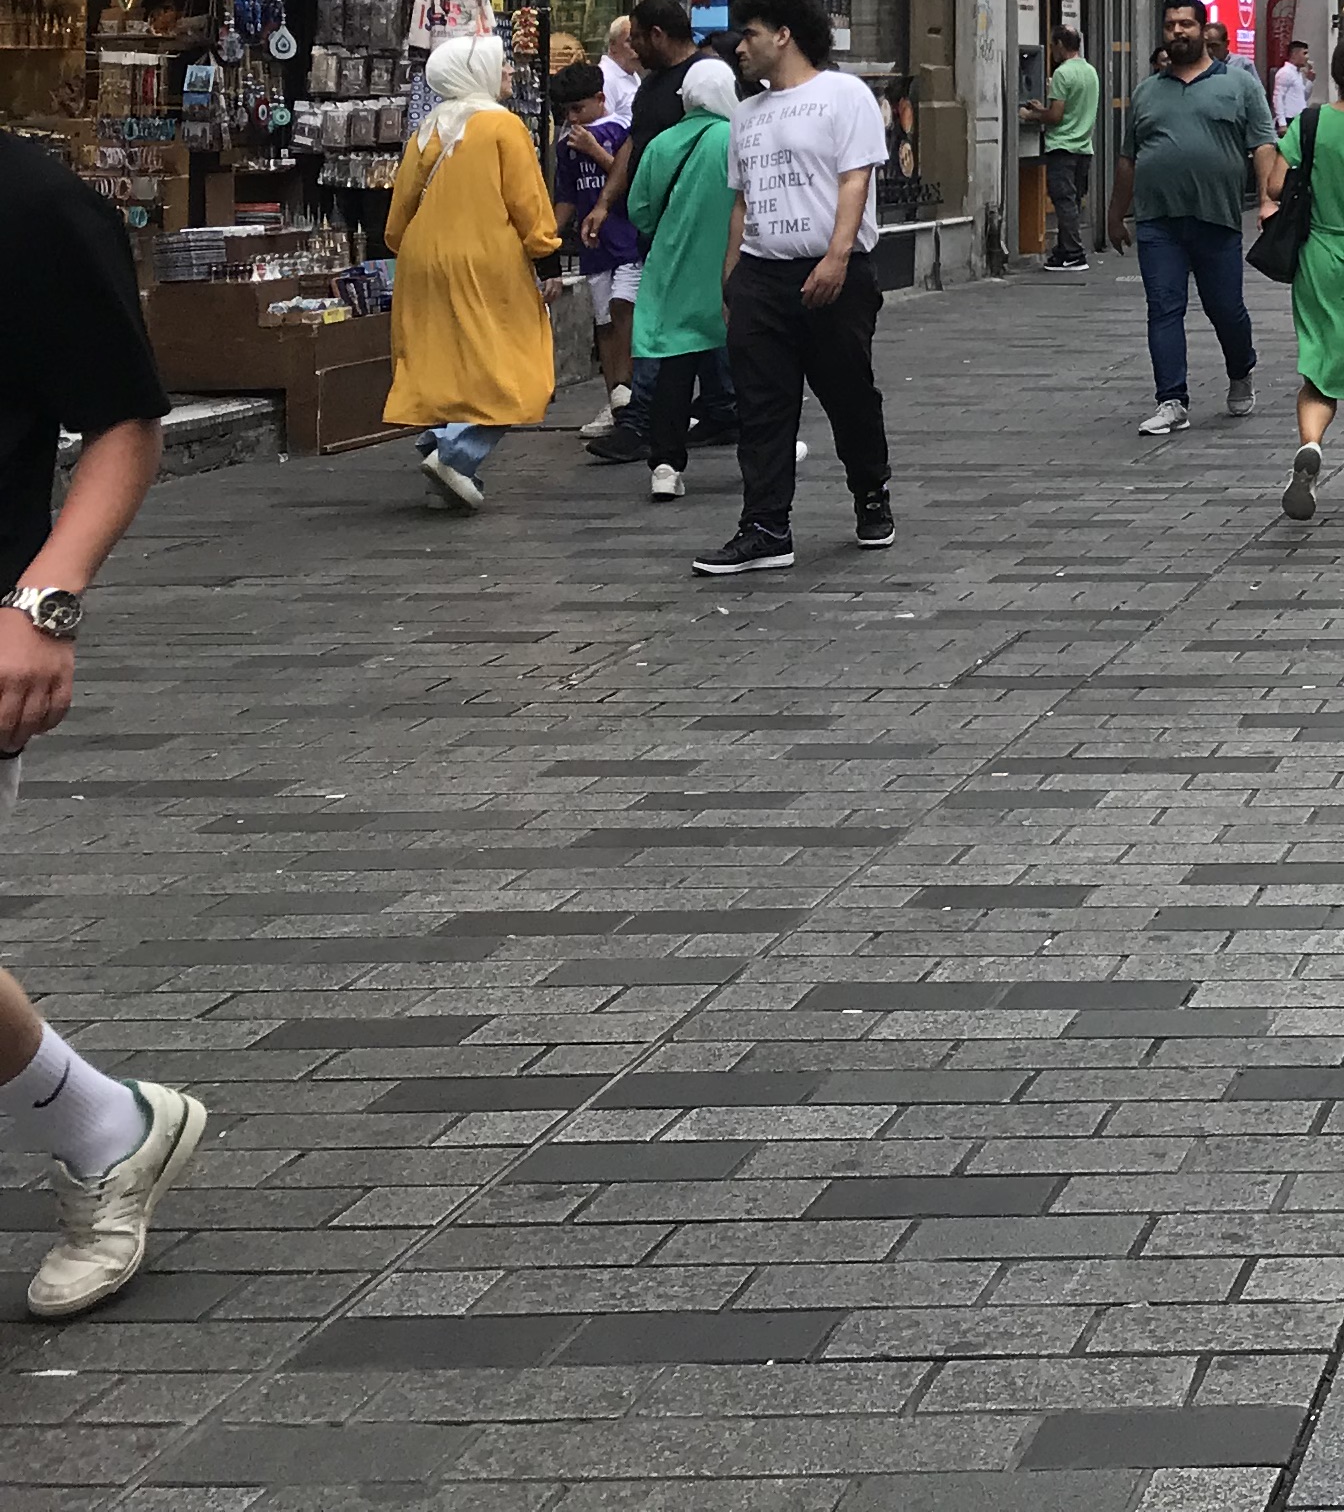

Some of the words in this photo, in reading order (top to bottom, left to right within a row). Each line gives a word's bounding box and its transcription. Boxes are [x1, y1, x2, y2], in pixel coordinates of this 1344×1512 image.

[779, 102, 829, 121] HAPPY
[758, 172, 815, 192] LONELY
[749, 198, 777, 216] THE
[768, 216, 811, 236] TIME
